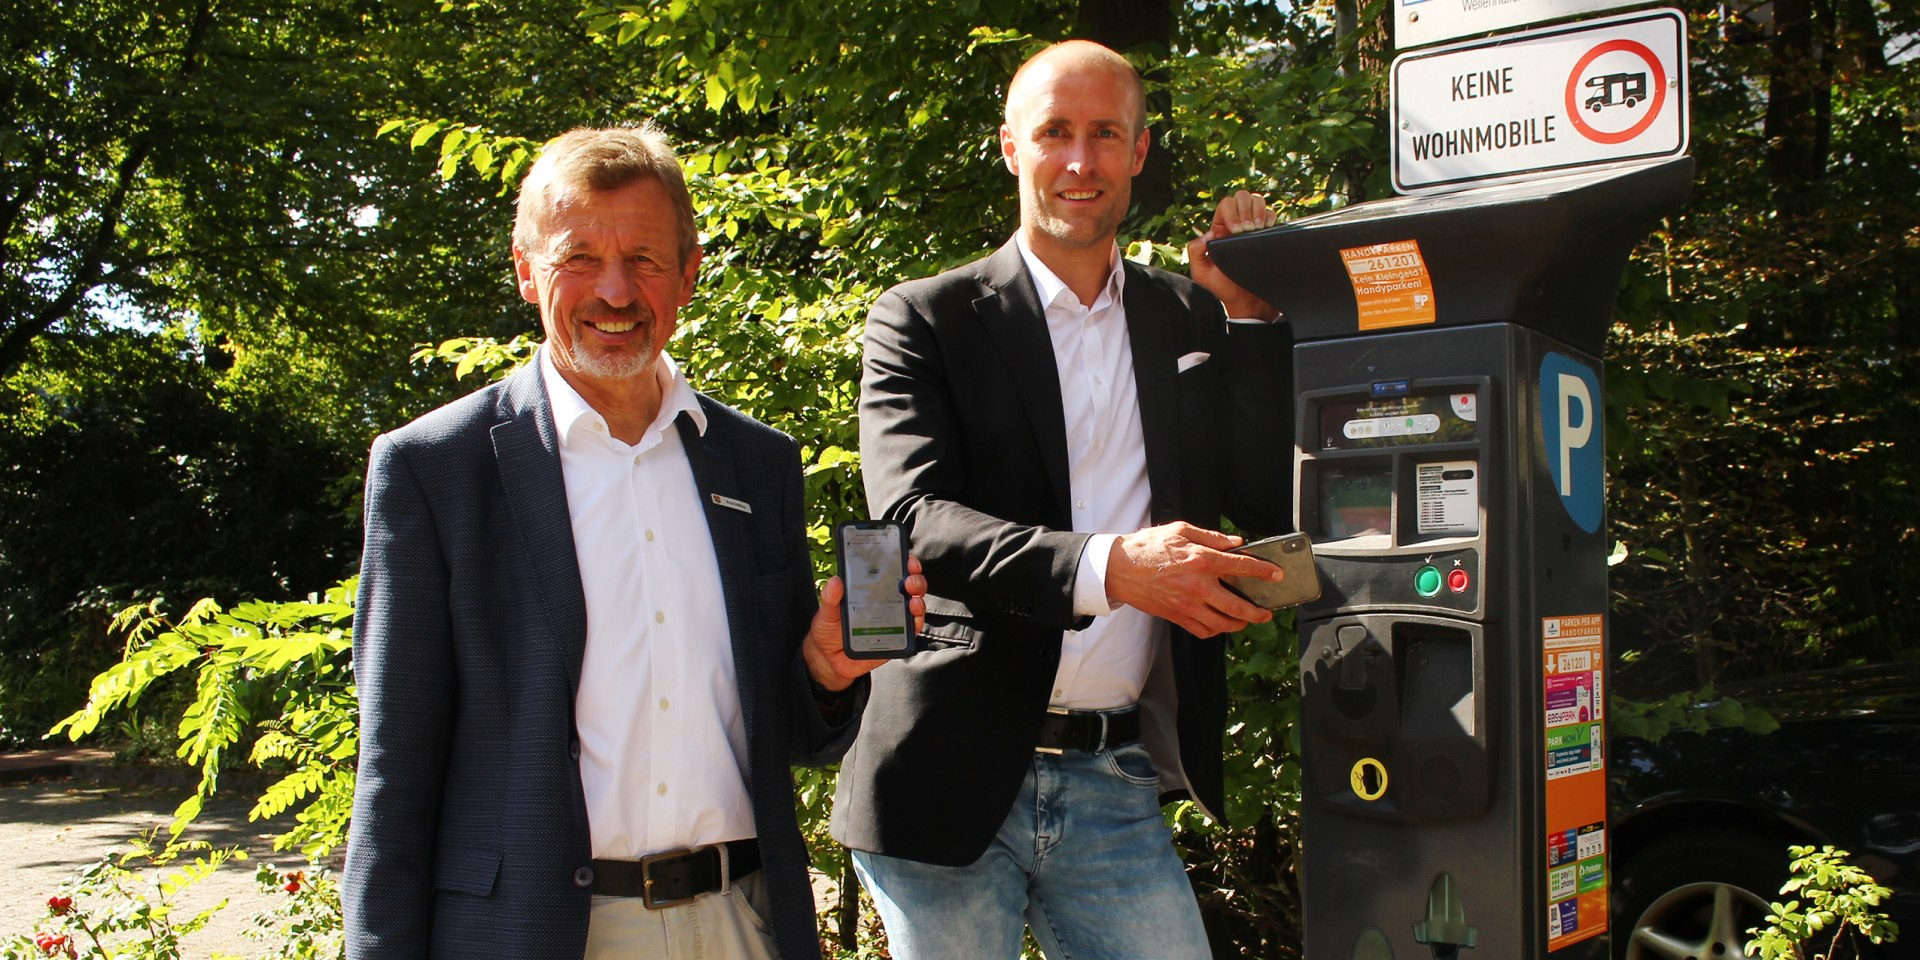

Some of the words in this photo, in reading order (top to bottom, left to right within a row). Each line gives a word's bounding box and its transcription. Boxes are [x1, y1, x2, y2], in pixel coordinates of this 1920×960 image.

[1451, 67, 1513, 101] KEINE
[1412, 115, 1556, 161] WOHNMOBILE
[1368, 254, 1416, 271] 261201
[1353, 275, 1374, 285] Kein
[1376, 268, 1423, 282] Kleingeld?
[1357, 279, 1422, 295] Handyparken!
[1558, 373, 1593, 496] P
[1561, 617, 1580, 627] PARKEN
[1581, 616, 1591, 626] PER
[1591, 615, 1601, 625] APP
[1561, 627, 1601, 637] HANDYPARKEN
[1562, 656, 1586, 671] 261201
[1560, 878, 1575, 890] phone
